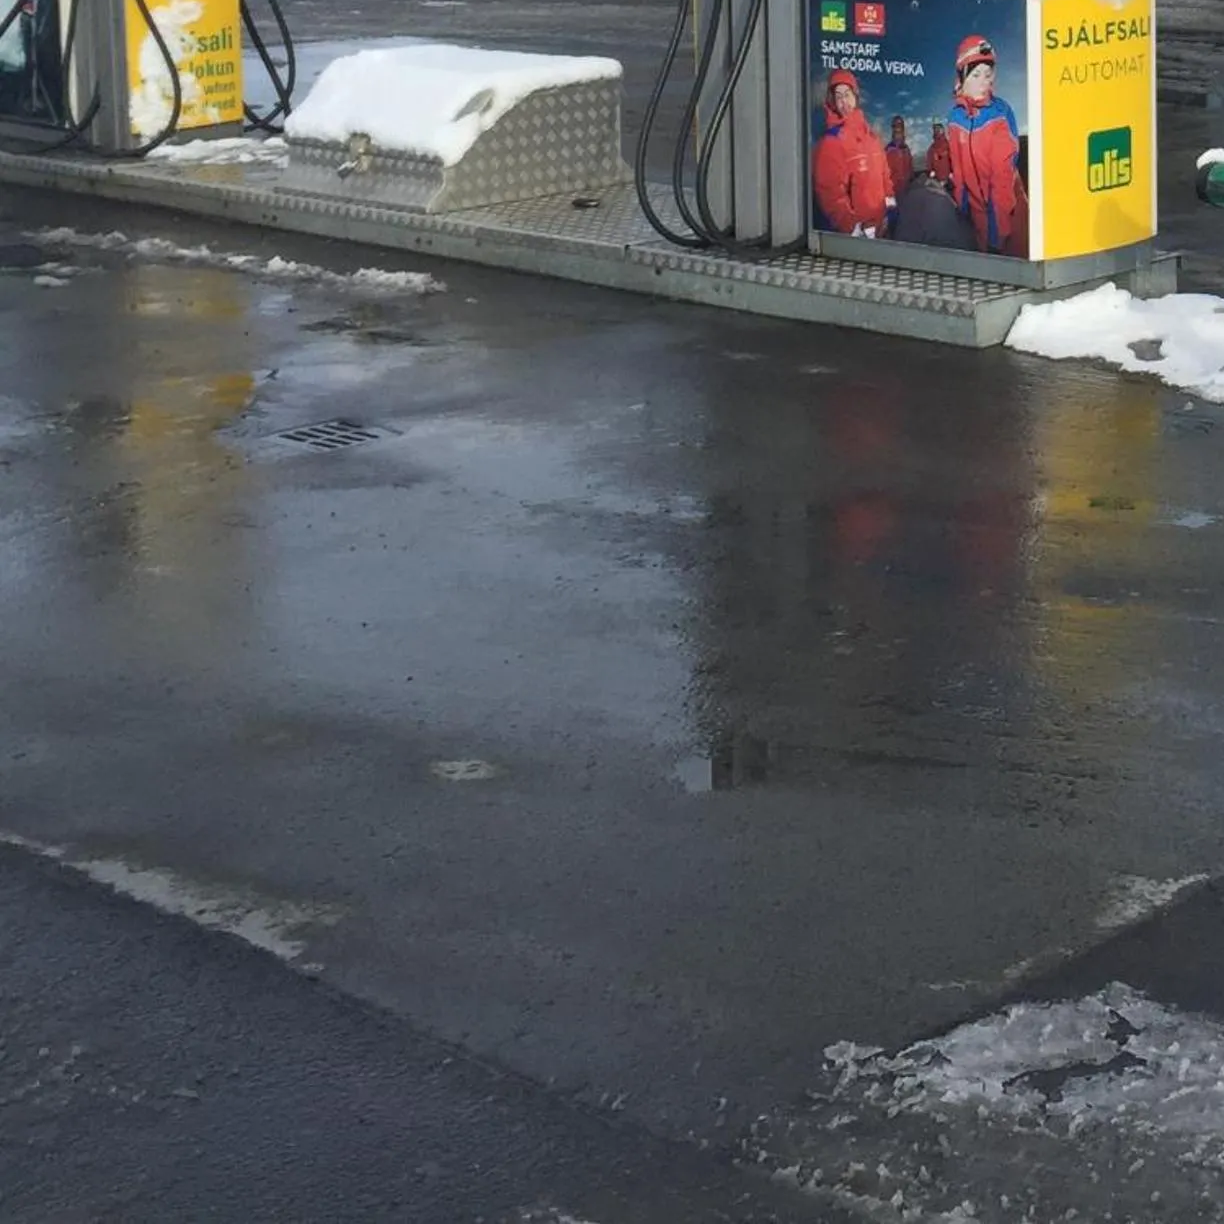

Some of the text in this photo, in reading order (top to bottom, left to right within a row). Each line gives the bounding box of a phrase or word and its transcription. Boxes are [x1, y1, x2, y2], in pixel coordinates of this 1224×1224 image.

[820, 40, 881, 57] SAMSTARF
[821, 56, 838, 69] TIL
[884, 60, 925, 77] VERKA
[1059, 54, 1145, 85] AUTOMAT
